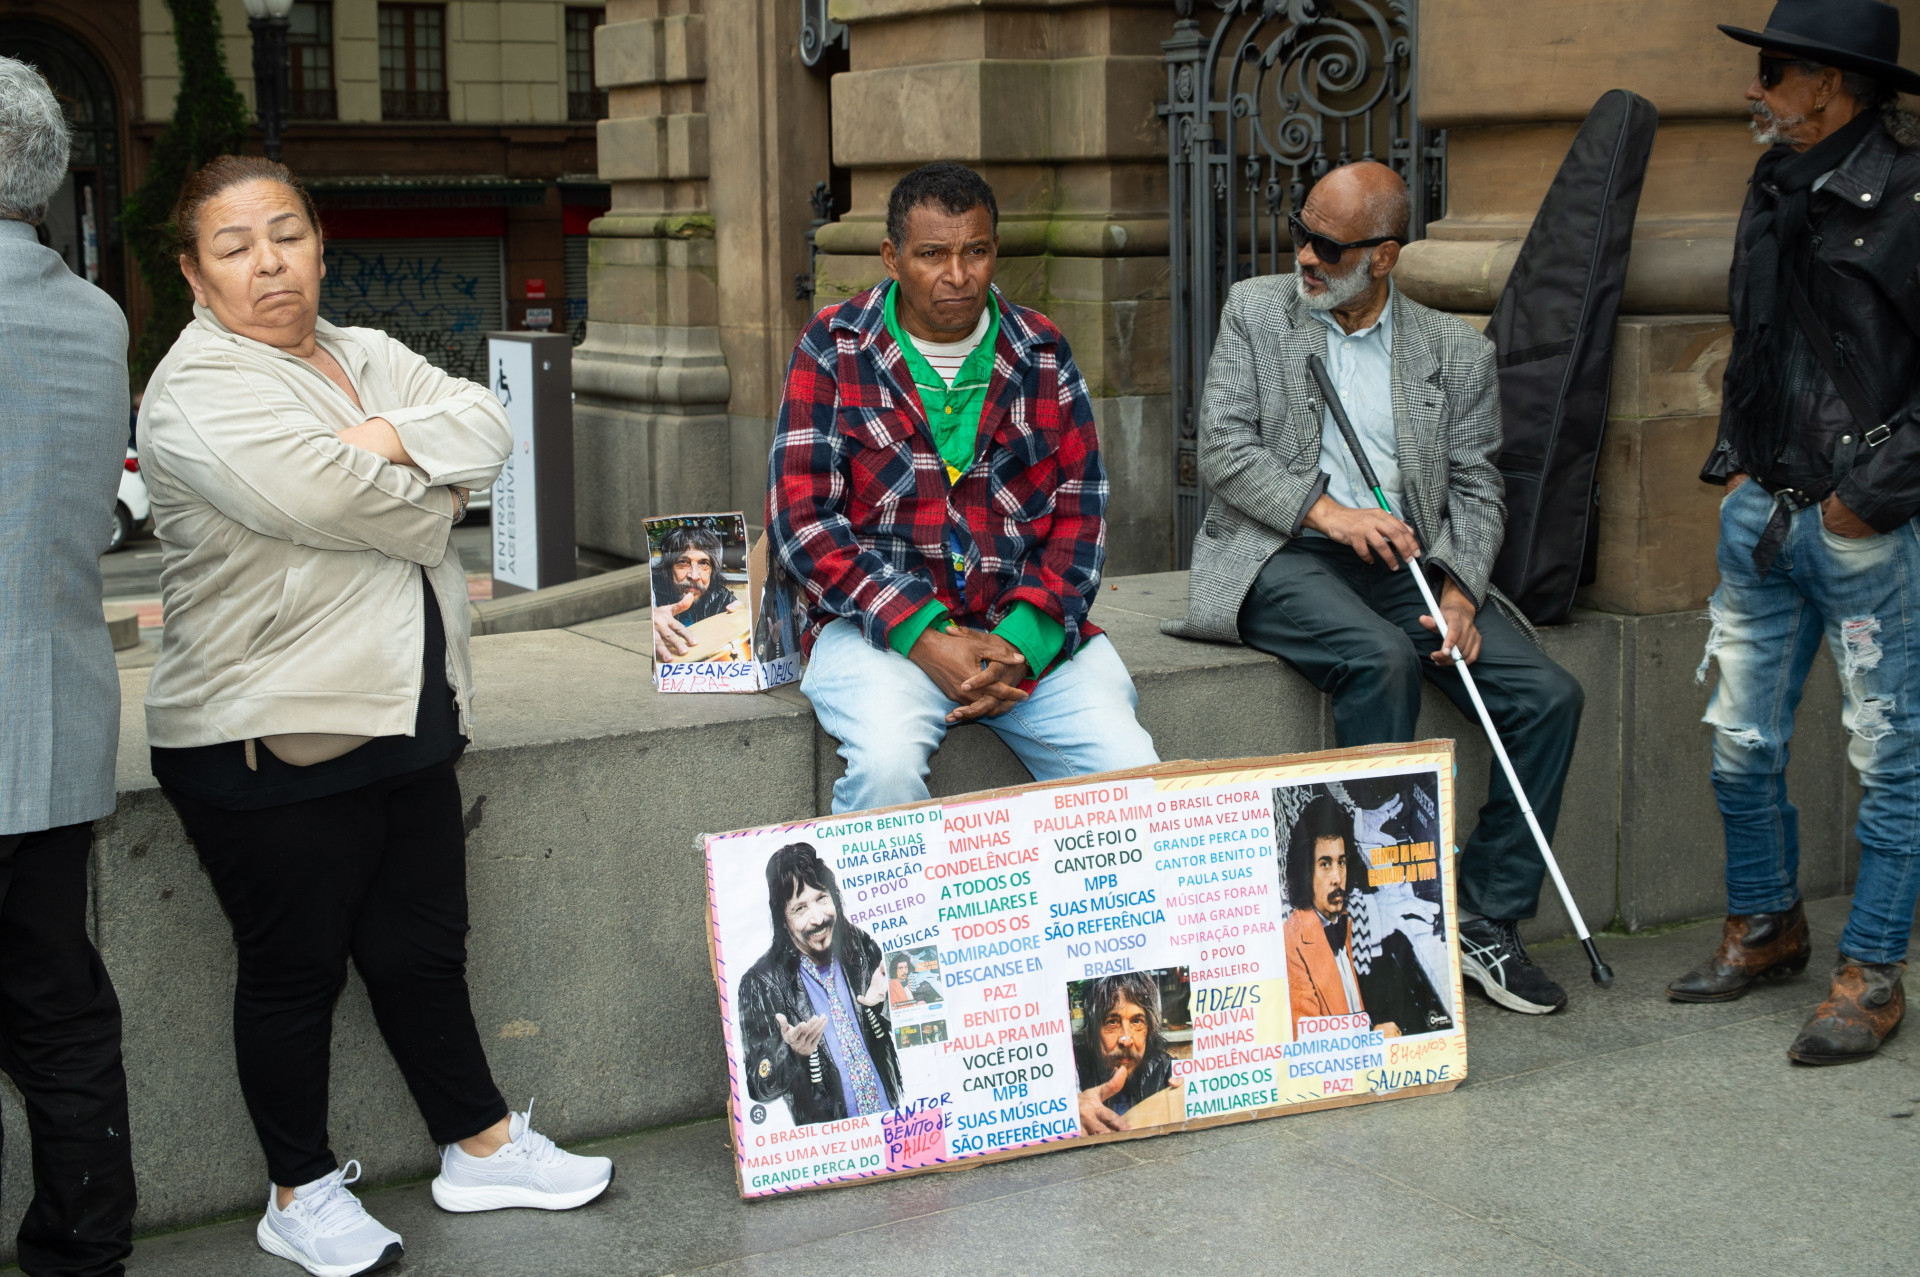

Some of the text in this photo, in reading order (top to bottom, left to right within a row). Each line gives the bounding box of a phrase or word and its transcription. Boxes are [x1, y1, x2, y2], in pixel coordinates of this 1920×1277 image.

[497, 471, 506, 571] ENTRAD
[506, 450, 516, 575] ACESSÍVE
[660, 663, 752, 679] DESCANSE
[661, 677, 685, 691] EM
[1054, 786, 1128, 810] BENITO DI
[1157, 790, 1260, 813] O BRASIL CHORA
[816, 810, 943, 839] CANTOR BENITO DI
[944, 808, 1010, 833] AQUI VAI
[1034, 804, 1153, 834] PAULA PRA MIM
[1149, 807, 1271, 833] MAIS UMA VEZ UMA
[842, 832, 923, 855] PAULA SUAS
[949, 830, 1011, 854] MINHAS
[1054, 828, 1137, 852] VOCÊ FOI O
[1154, 826, 1269, 852] GRANDE PERCA DO
[836, 843, 927, 870] UMA GRANDE
[924, 847, 1039, 880] CONDELÊNCIAS
[1054, 849, 1143, 874] CANTOR DO
[1155, 845, 1272, 871] CANTOR BENITO DI
[857, 877, 908, 901] O POVO
[940, 871, 1031, 900] A TODOS OS
[1084, 874, 1118, 892] MPB
[1178, 867, 1253, 887] PAULA SUAS
[850, 893, 926, 925] BRASILEIRO
[938, 891, 1039, 922] FAMILIARES E
[1050, 889, 1156, 918] SUAS MÚSICAS
[1166, 884, 1268, 908] MÚSICAS FORAM
[872, 915, 908, 933] PARA
[1044, 909, 1165, 941] SÃO REFERÊNCIA
[1178, 904, 1261, 926] UMA GRANDE
[882, 925, 940, 953] MÚSICAS
[951, 915, 1030, 942] TODOS OS
[1243, 921, 1276, 936] PARA
[1067, 933, 1147, 959] NO NOSSO
[1200, 944, 1246, 962] O POVO
[945, 960, 1024, 988] DESCANSE
[1084, 957, 1135, 977] BRASIL
[1191, 962, 1260, 983] BRASILEIRO
[983, 983, 1018, 1002] PAZ!
[963, 1001, 1040, 1028] BENITO DI
[1193, 1007, 1255, 1031] AQUI VAI
[1299, 1013, 1369, 1035] TODOS OS
[943, 1019, 1065, 1054] PAULA PRA MIM
[1196, 1028, 1255, 1051] MINHAS
[1282, 1031, 1384, 1059] ADMIRADORES
[962, 1042, 1048, 1071] VOCÊ FOI O
[1172, 1045, 1283, 1076] CONDELÊNCIAS
[1289, 1053, 1383, 1079] DESCANSE EM
[962, 1063, 1054, 1092] CANTOR DO
[1187, 1068, 1273, 1096] A TODOS OS
[1323, 1078, 1354, 1095] PAZ!
[1366, 1064, 1450, 1092] SAUDADE
[993, 1083, 1028, 1102] MPB
[1186, 1088, 1279, 1118] FAMILIARES E
[881, 1092, 953, 1126] CANTOR
[957, 1097, 1068, 1131] SUAS MÚSICAS
[756, 1116, 870, 1147] O BRASIL CHORA
[884, 1118, 935, 1144] BENITO
[952, 1117, 1078, 1154] SÃO REFERÊNCIA
[748, 1134, 883, 1169] MAIS UMA VEZ UMA
[891, 1131, 942, 1163] PAULO
[752, 1154, 880, 1188] GRANDE PERCA DO
